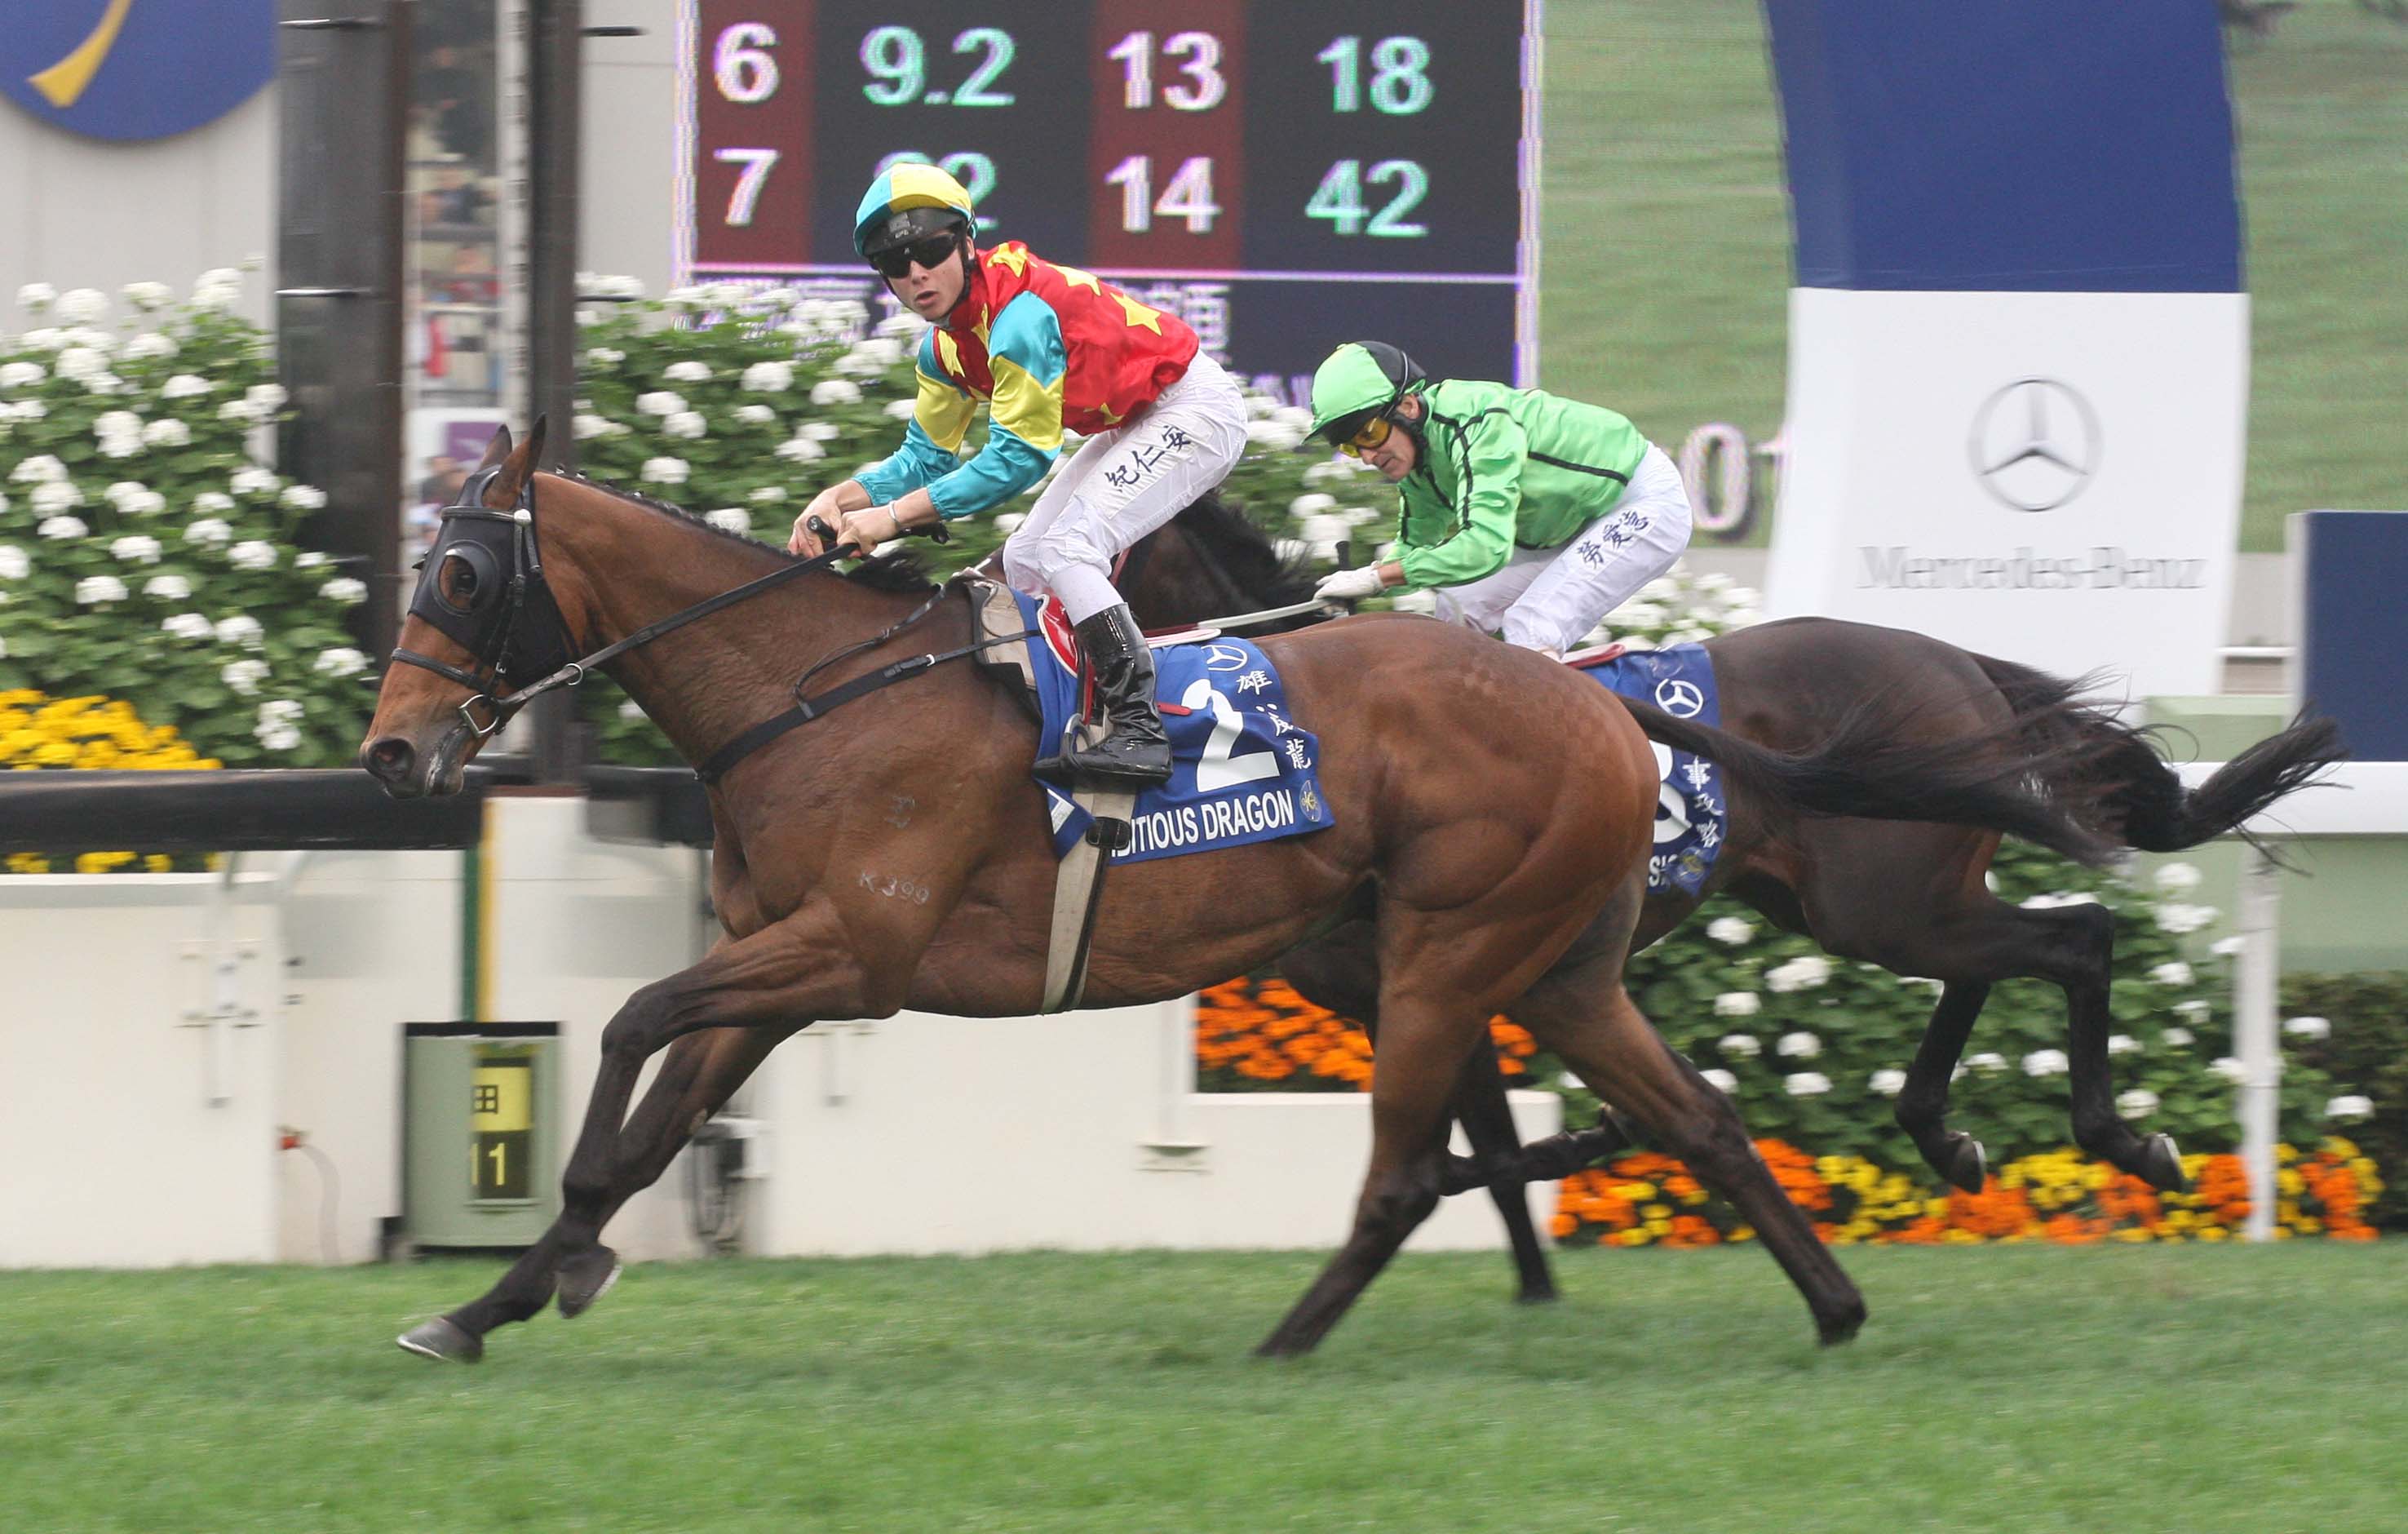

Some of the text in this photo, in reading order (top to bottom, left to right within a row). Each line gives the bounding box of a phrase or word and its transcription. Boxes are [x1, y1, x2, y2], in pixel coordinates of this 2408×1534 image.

[714, 23, 1434, 116] 6 9.2 13 18
[713, 149, 1428, 238] 7 2 14 42
[1855, 546, 2209, 589] Mercedes-Benz
[1182, 679, 1280, 792] 2
[1112, 807, 1198, 858] ITIOUS
[1203, 789, 1294, 840] DRAGON
